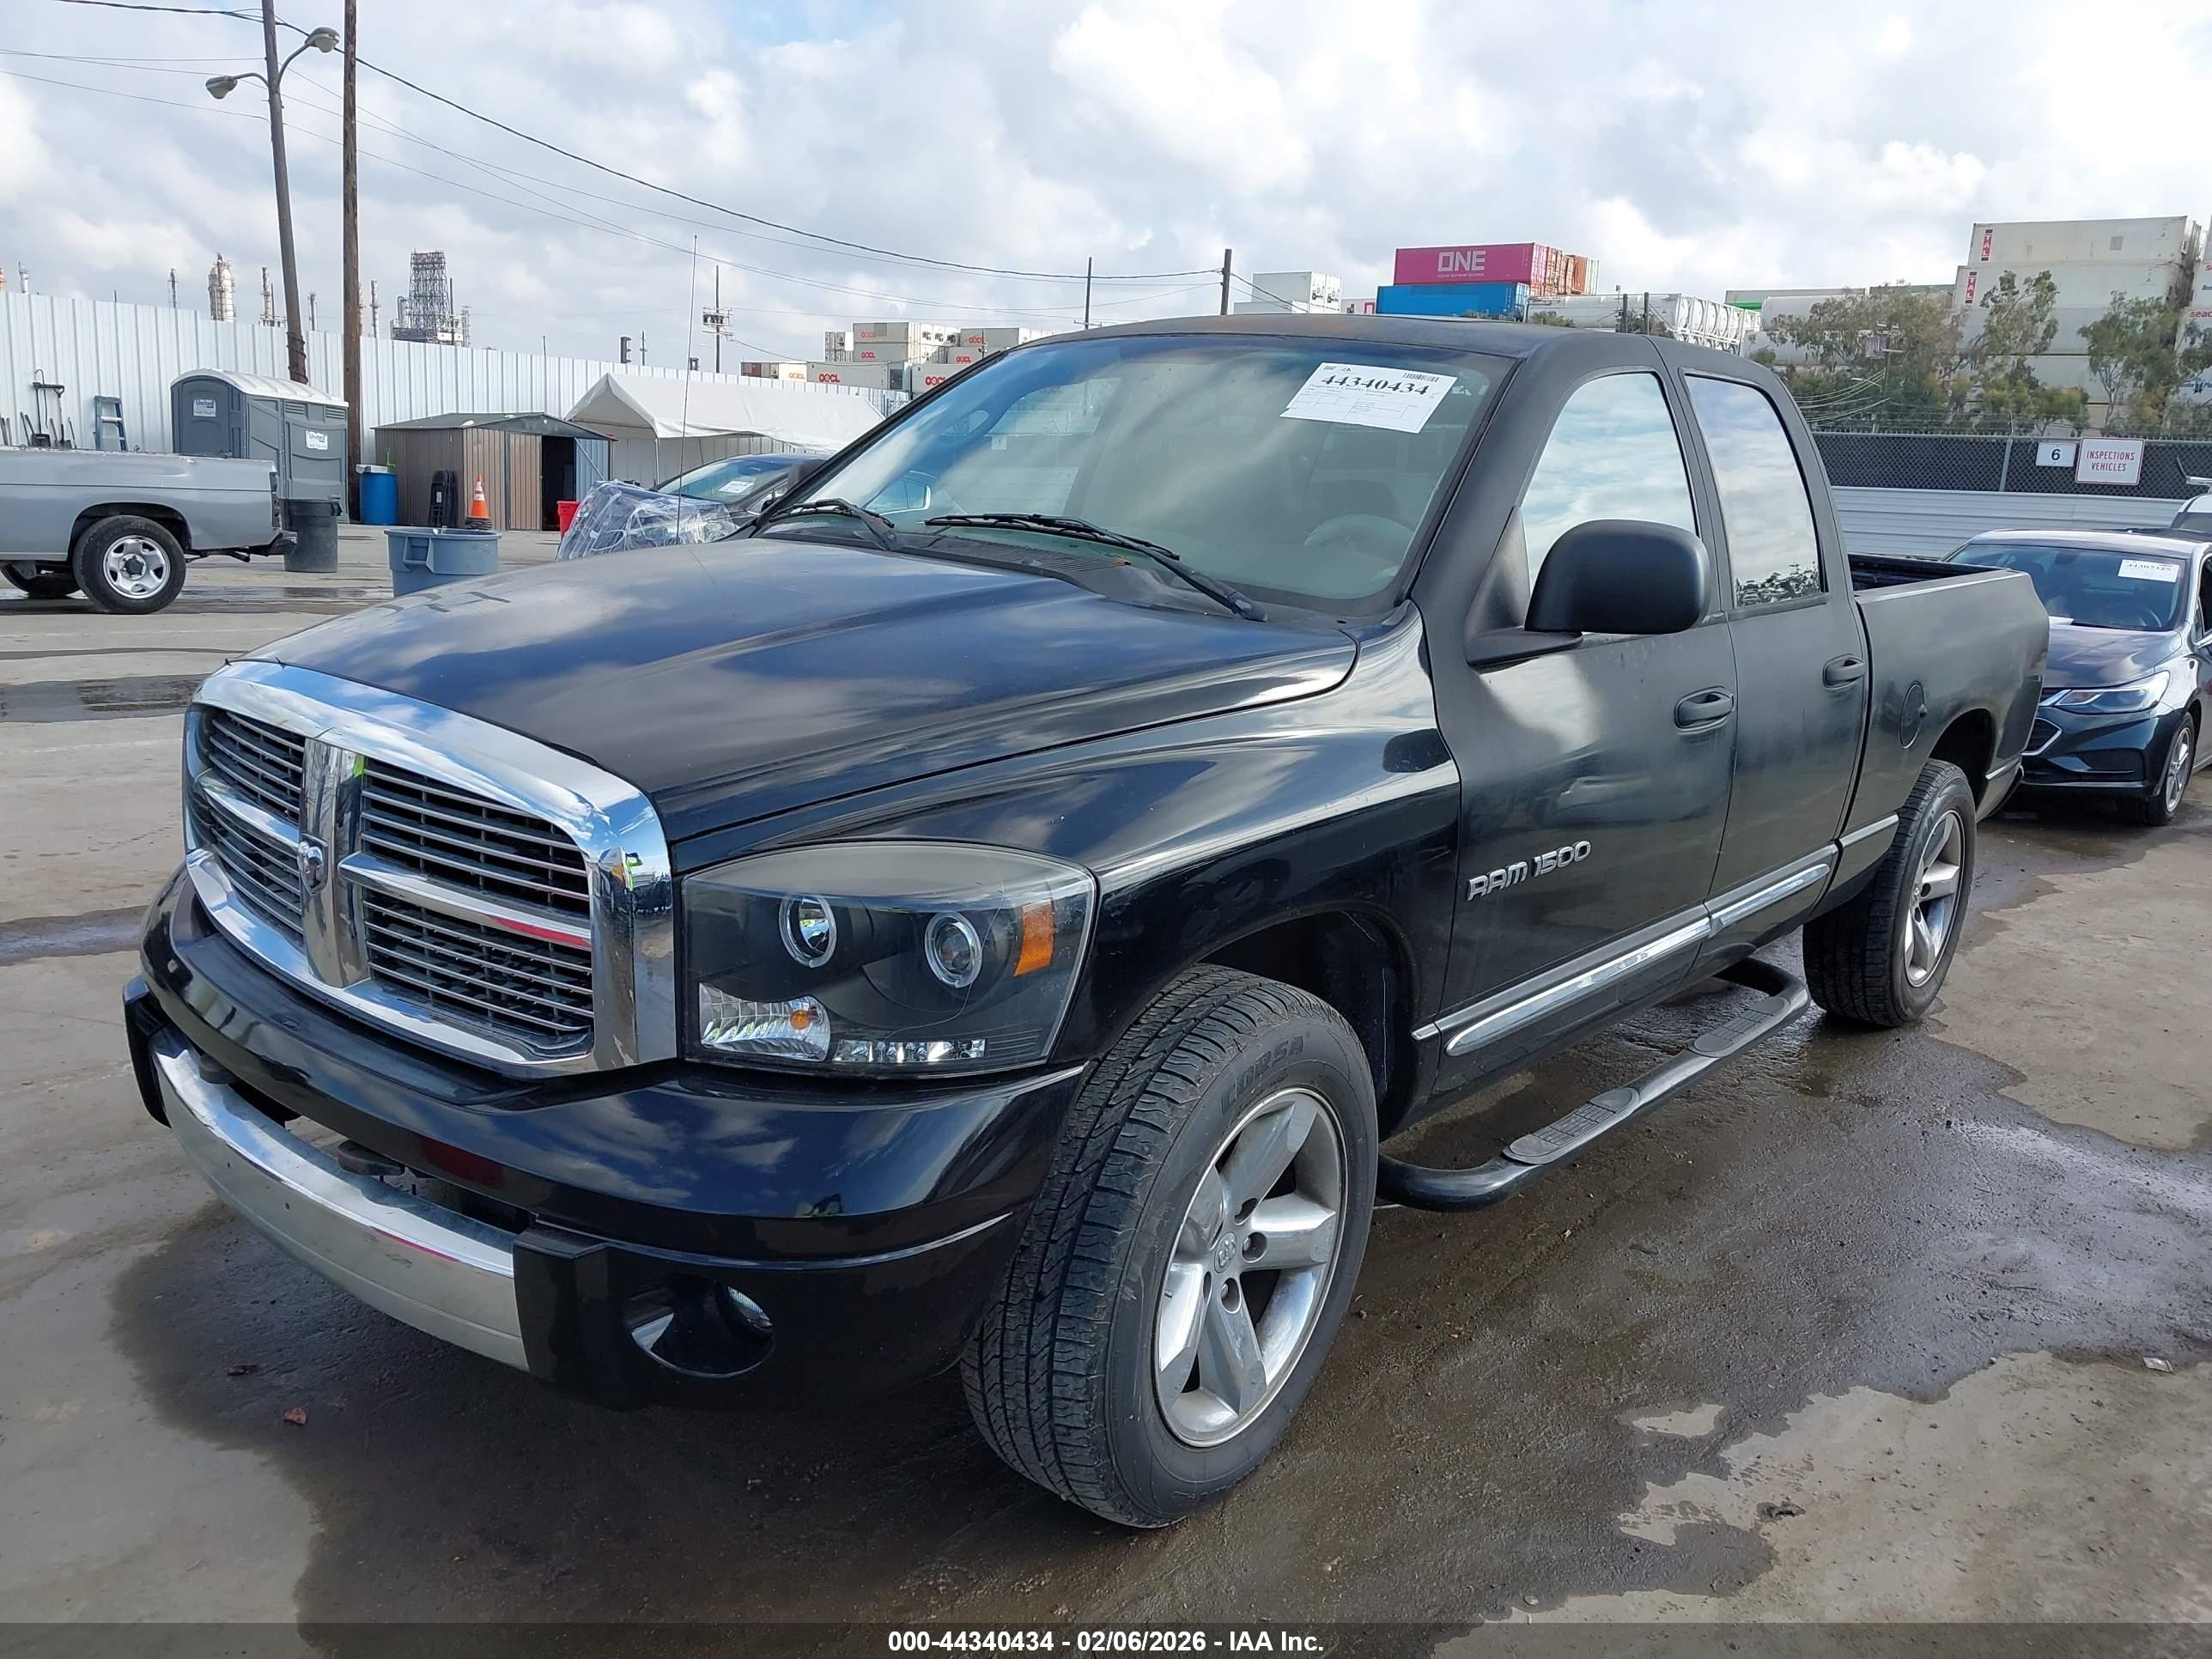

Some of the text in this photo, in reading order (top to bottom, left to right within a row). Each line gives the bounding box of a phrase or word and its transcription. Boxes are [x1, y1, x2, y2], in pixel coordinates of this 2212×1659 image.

[1983, 235, 1992, 256] TAL
[1437, 251, 1486, 271] ONE
[1967, 276, 1976, 298] TAL
[818, 373, 841, 383] OOCL
[1321, 374, 1429, 396] 44340434
[2051, 448, 2061, 461] 6
[2087, 450, 2135, 461] INSPECTIONS
[2091, 463, 2127, 471] VEHICLES
[1467, 841, 1591, 902] RAM 1500
